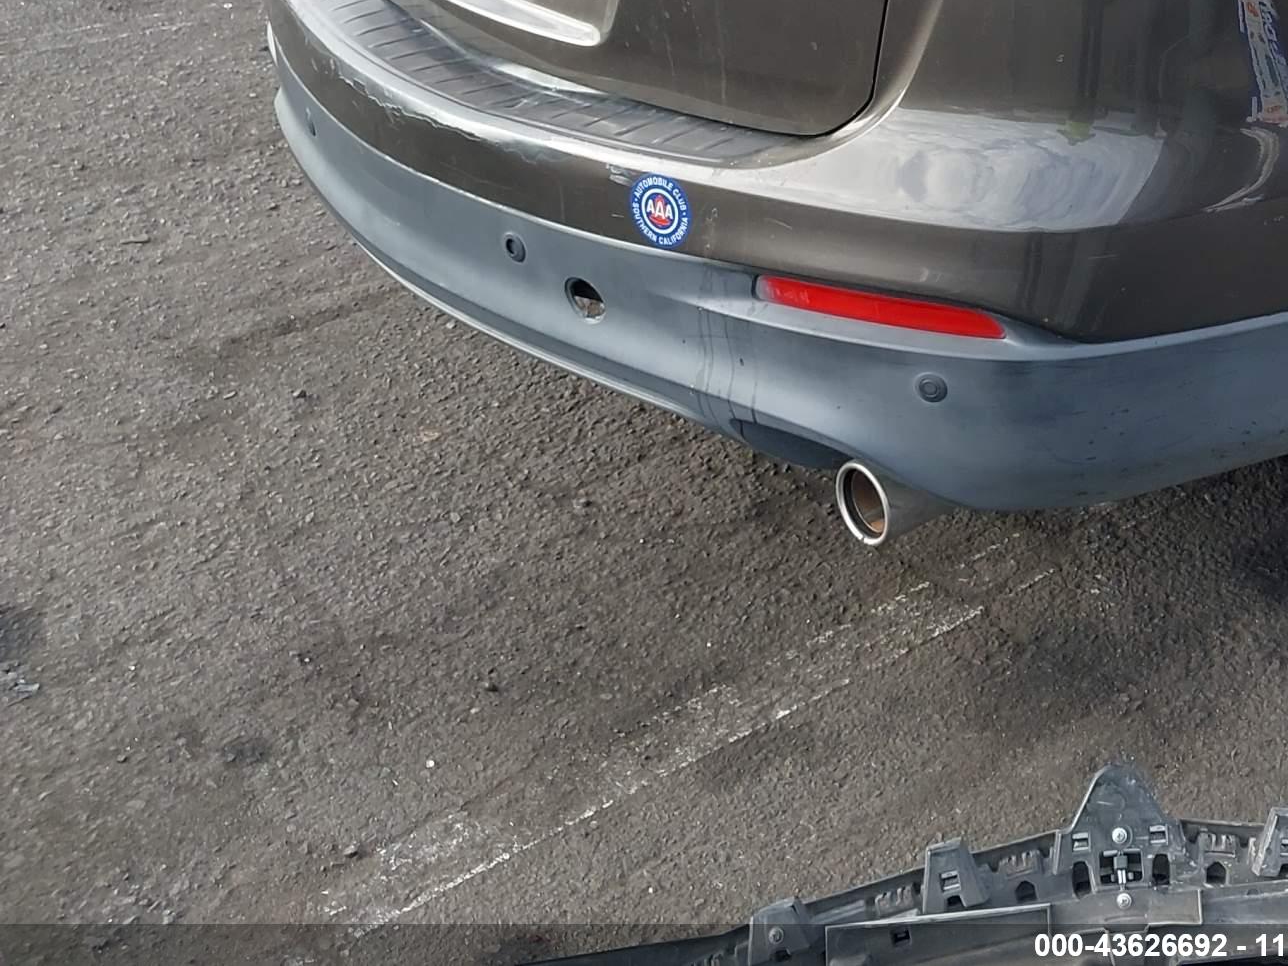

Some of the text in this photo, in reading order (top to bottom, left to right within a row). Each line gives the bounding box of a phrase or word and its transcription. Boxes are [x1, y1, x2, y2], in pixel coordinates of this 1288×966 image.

[633, 176, 687, 211] AUTOMOBILE CLUB
[646, 198, 674, 220] AAA
[632, 201, 689, 246] SOUTHERN CALIFORNIA
